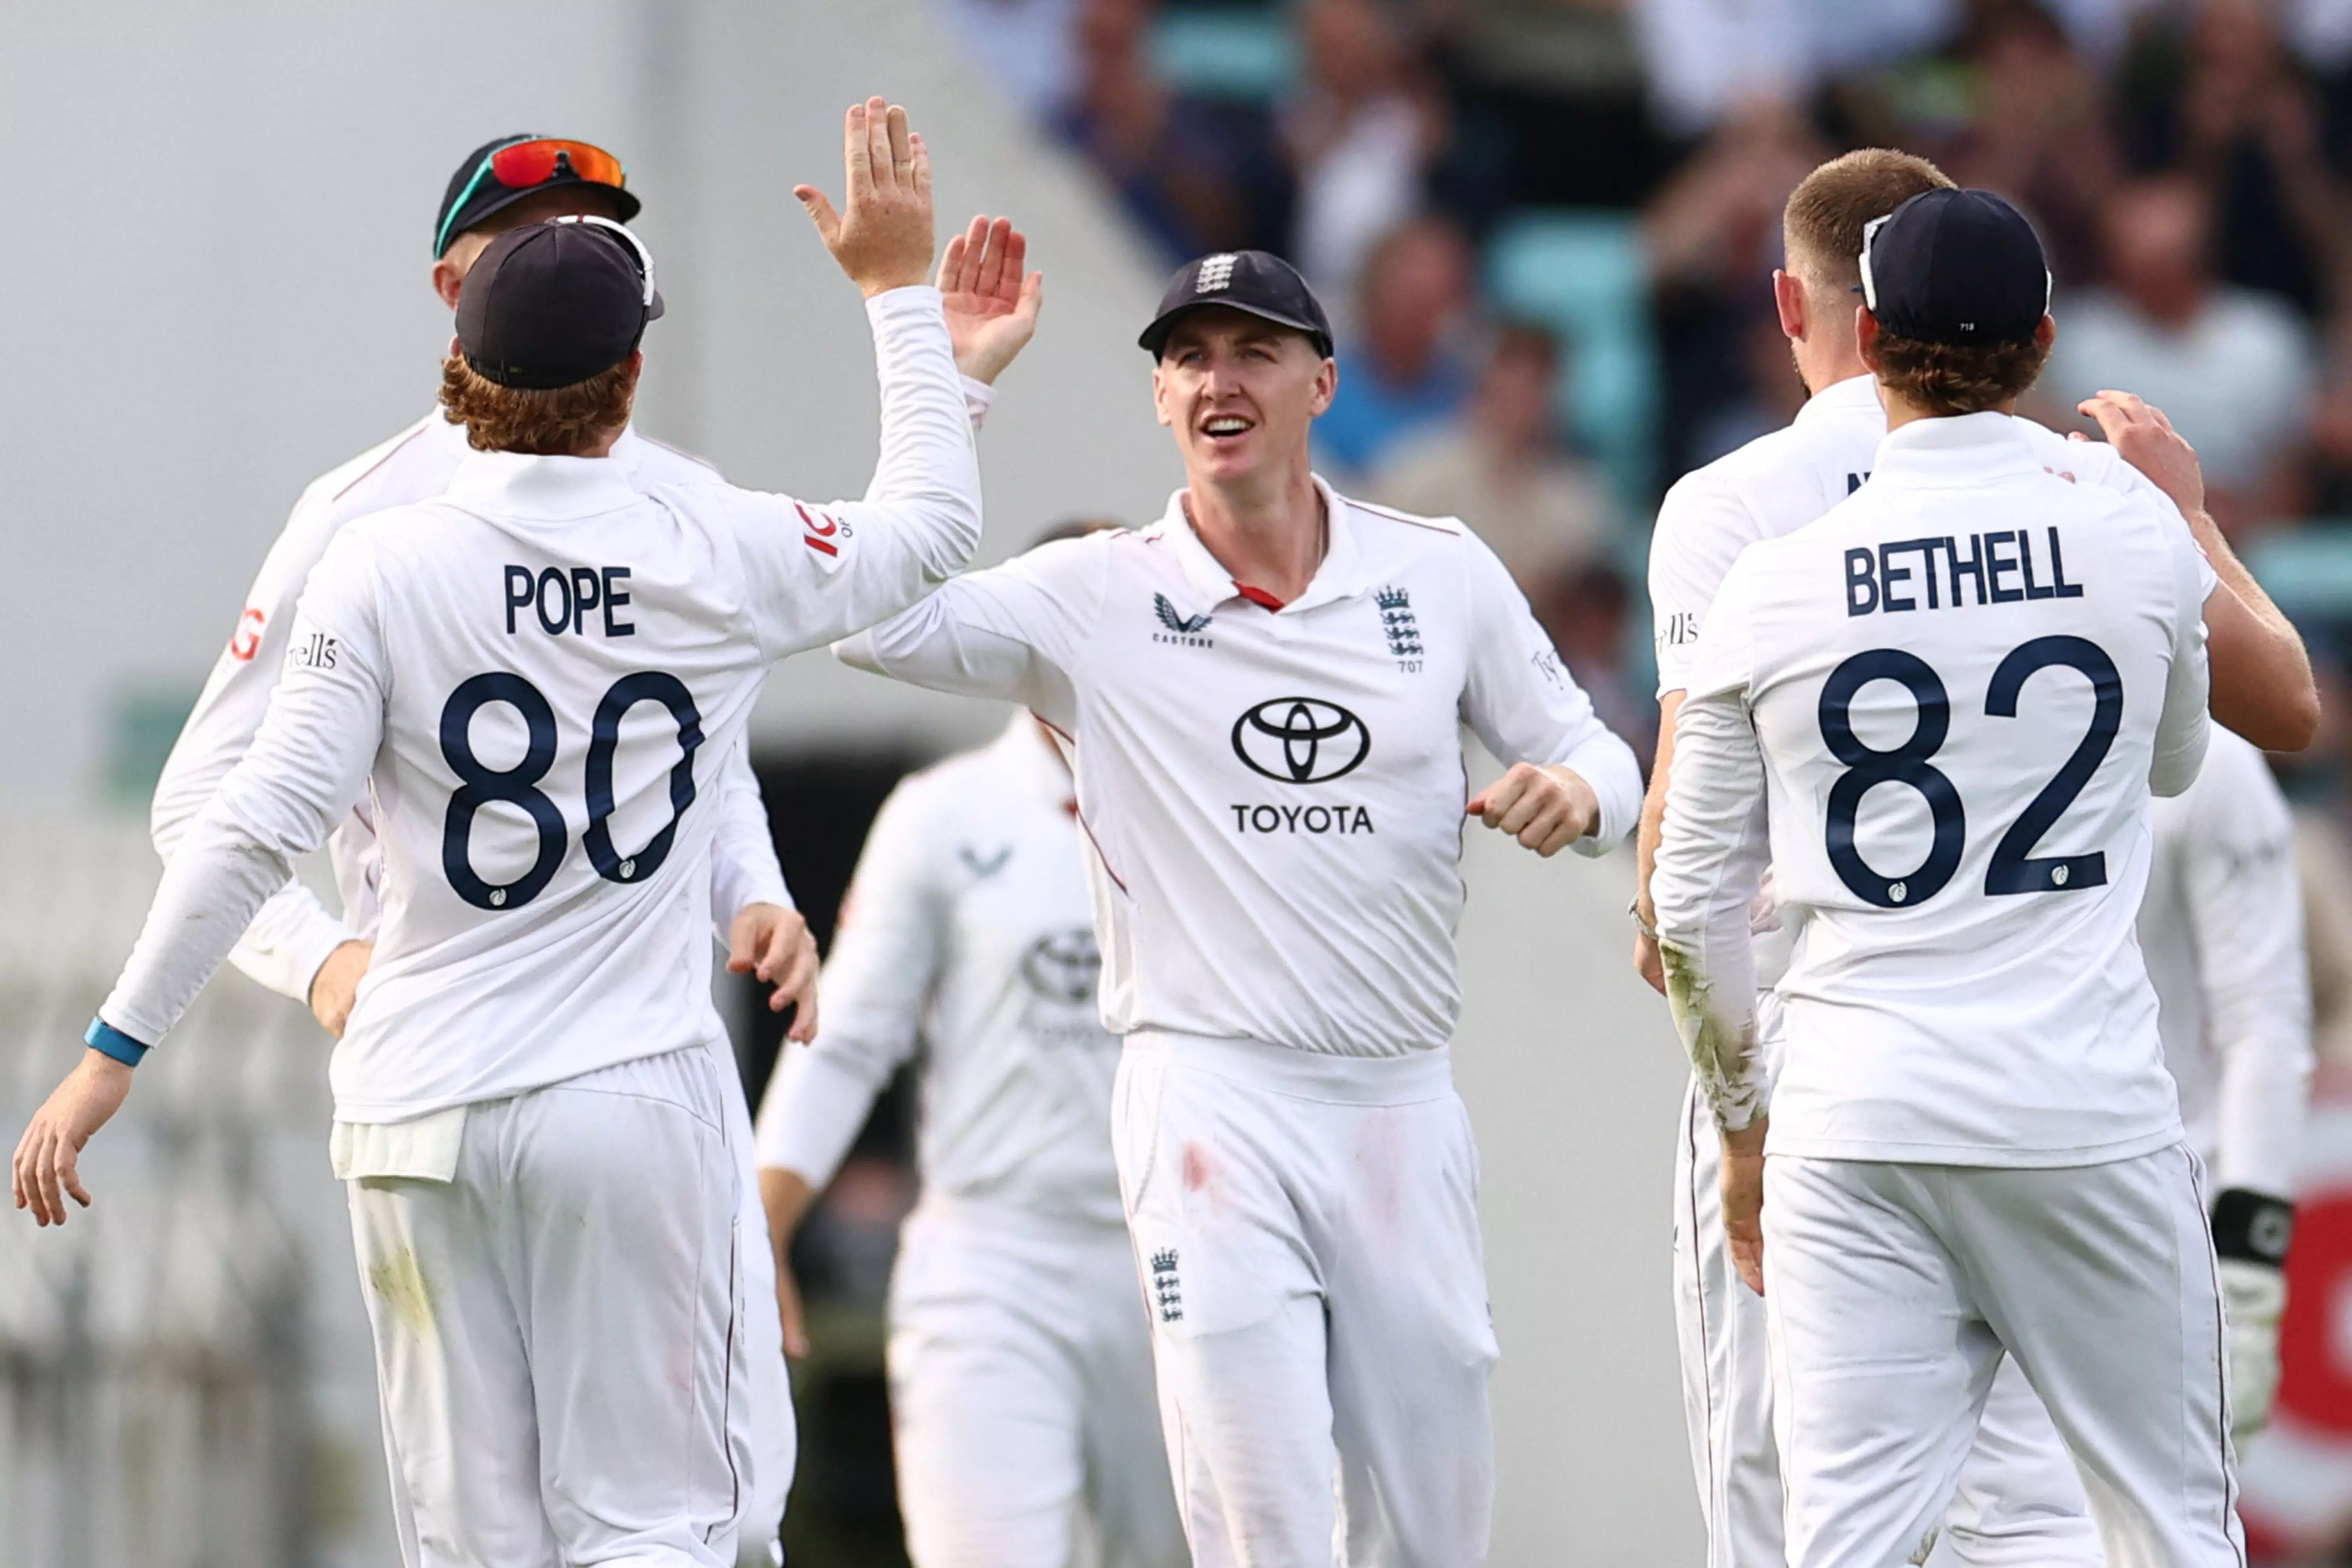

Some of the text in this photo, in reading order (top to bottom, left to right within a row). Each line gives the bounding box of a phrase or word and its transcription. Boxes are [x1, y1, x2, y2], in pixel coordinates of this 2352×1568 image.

[505, 564, 635, 638] POPE
[1845, 526, 2084, 617] BETHELL
[1152, 632, 1214, 648] CASTORE
[1397, 660, 1423, 673] 707
[440, 671, 706, 911] 80
[1818, 635, 2124, 909] 82
[1230, 804, 1374, 834] TOYOTA
